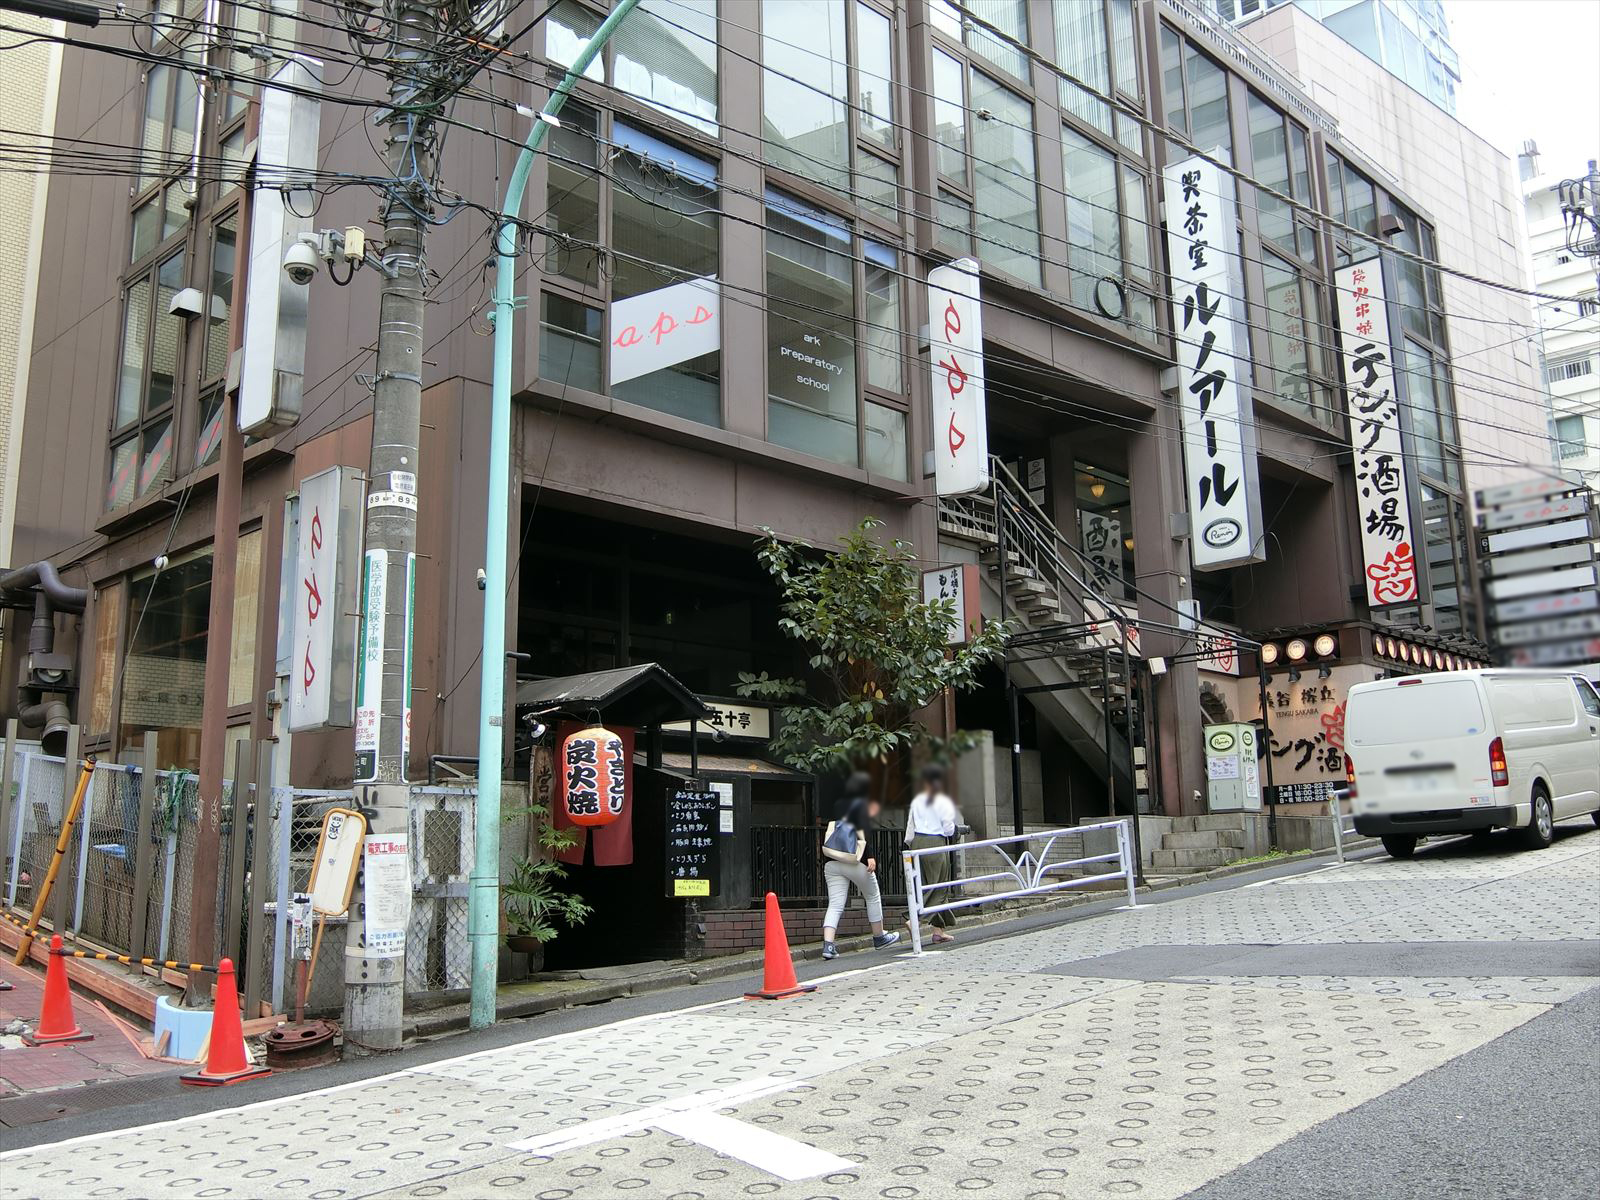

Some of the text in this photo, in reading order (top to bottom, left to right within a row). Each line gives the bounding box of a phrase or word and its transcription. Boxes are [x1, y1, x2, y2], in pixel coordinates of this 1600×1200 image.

[780, 346, 843, 375] preparatory
[803, 333, 821, 346] ark
[1182, 170, 1240, 512] 喫茶室 ルノアール
[796, 373, 830, 392] school
[1351, 343, 1404, 542] テング酒場
[367, 560, 383, 662] 医学部受験予備校
[711, 710, 751, 730] 五十亭
[566, 739, 600, 816] 炭火焼
[605, 739, 625, 815] やきとり
